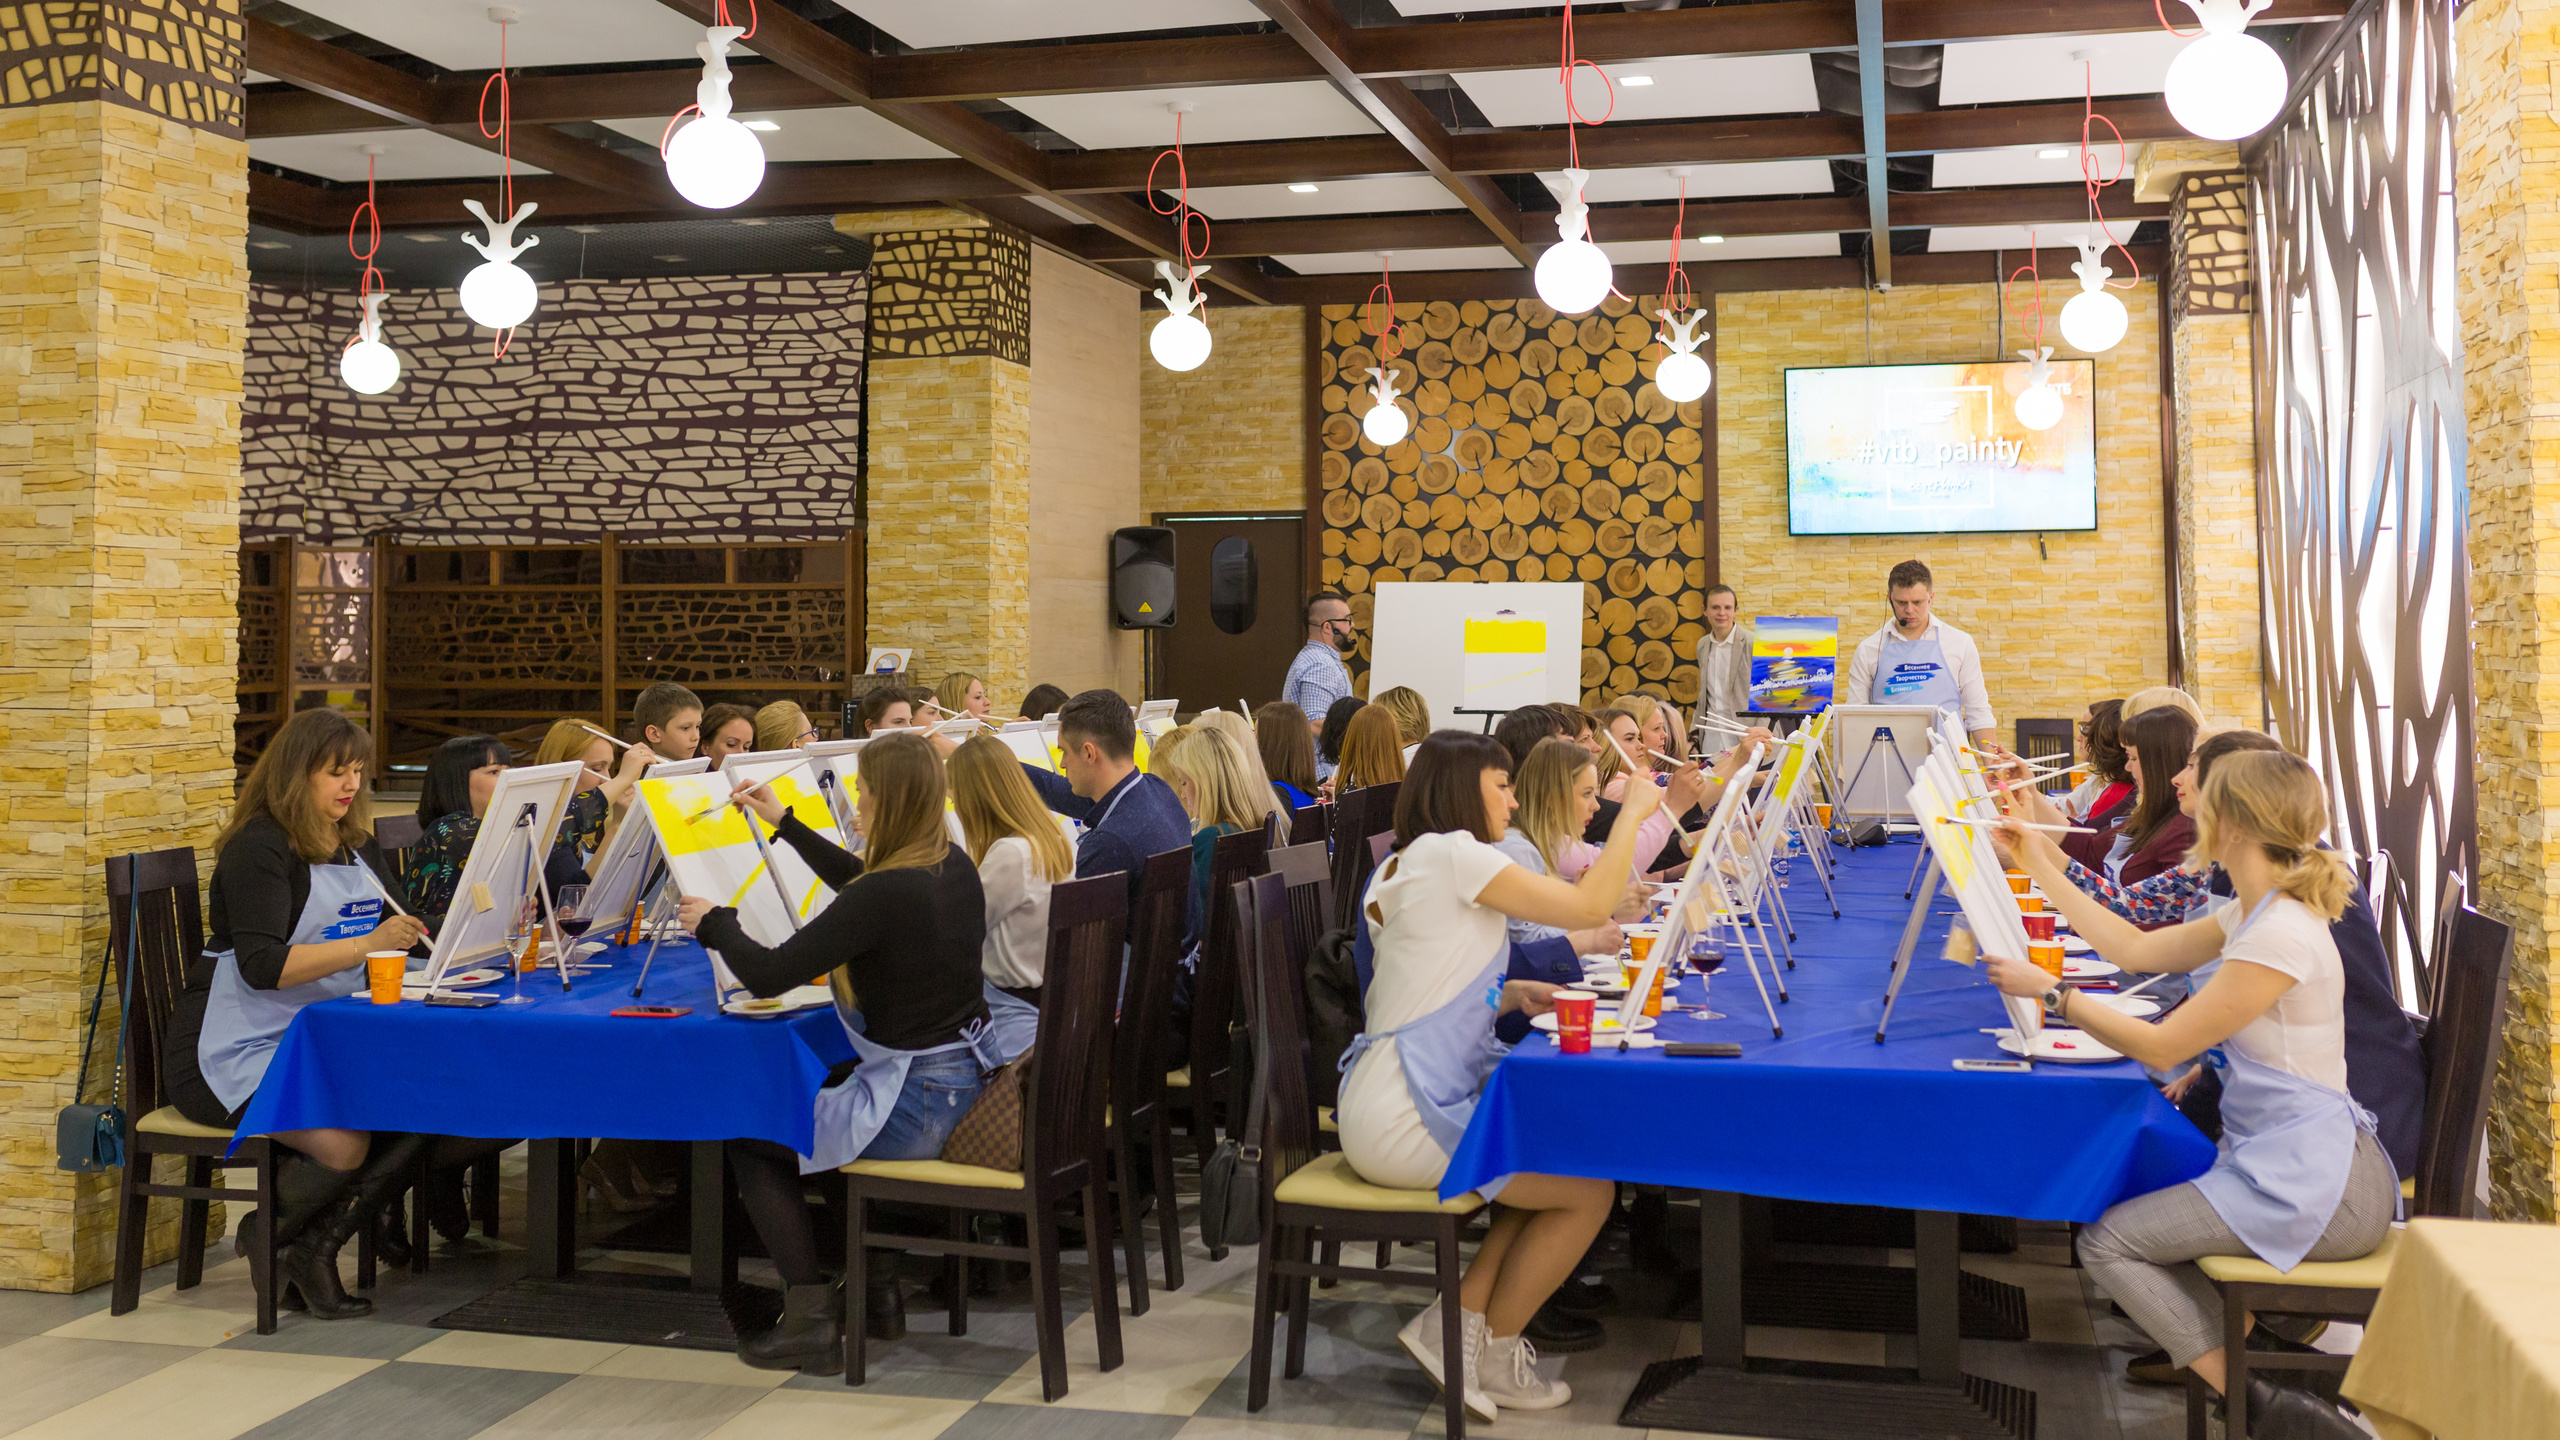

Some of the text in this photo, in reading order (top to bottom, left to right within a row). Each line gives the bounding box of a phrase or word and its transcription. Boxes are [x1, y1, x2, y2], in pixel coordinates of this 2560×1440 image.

[1857, 435, 2023, 469] #vtb_painty
[1895, 674, 1928, 682] Творчество
[351, 903, 379, 914] Весеннее
[339, 922, 374, 935] Творчество
